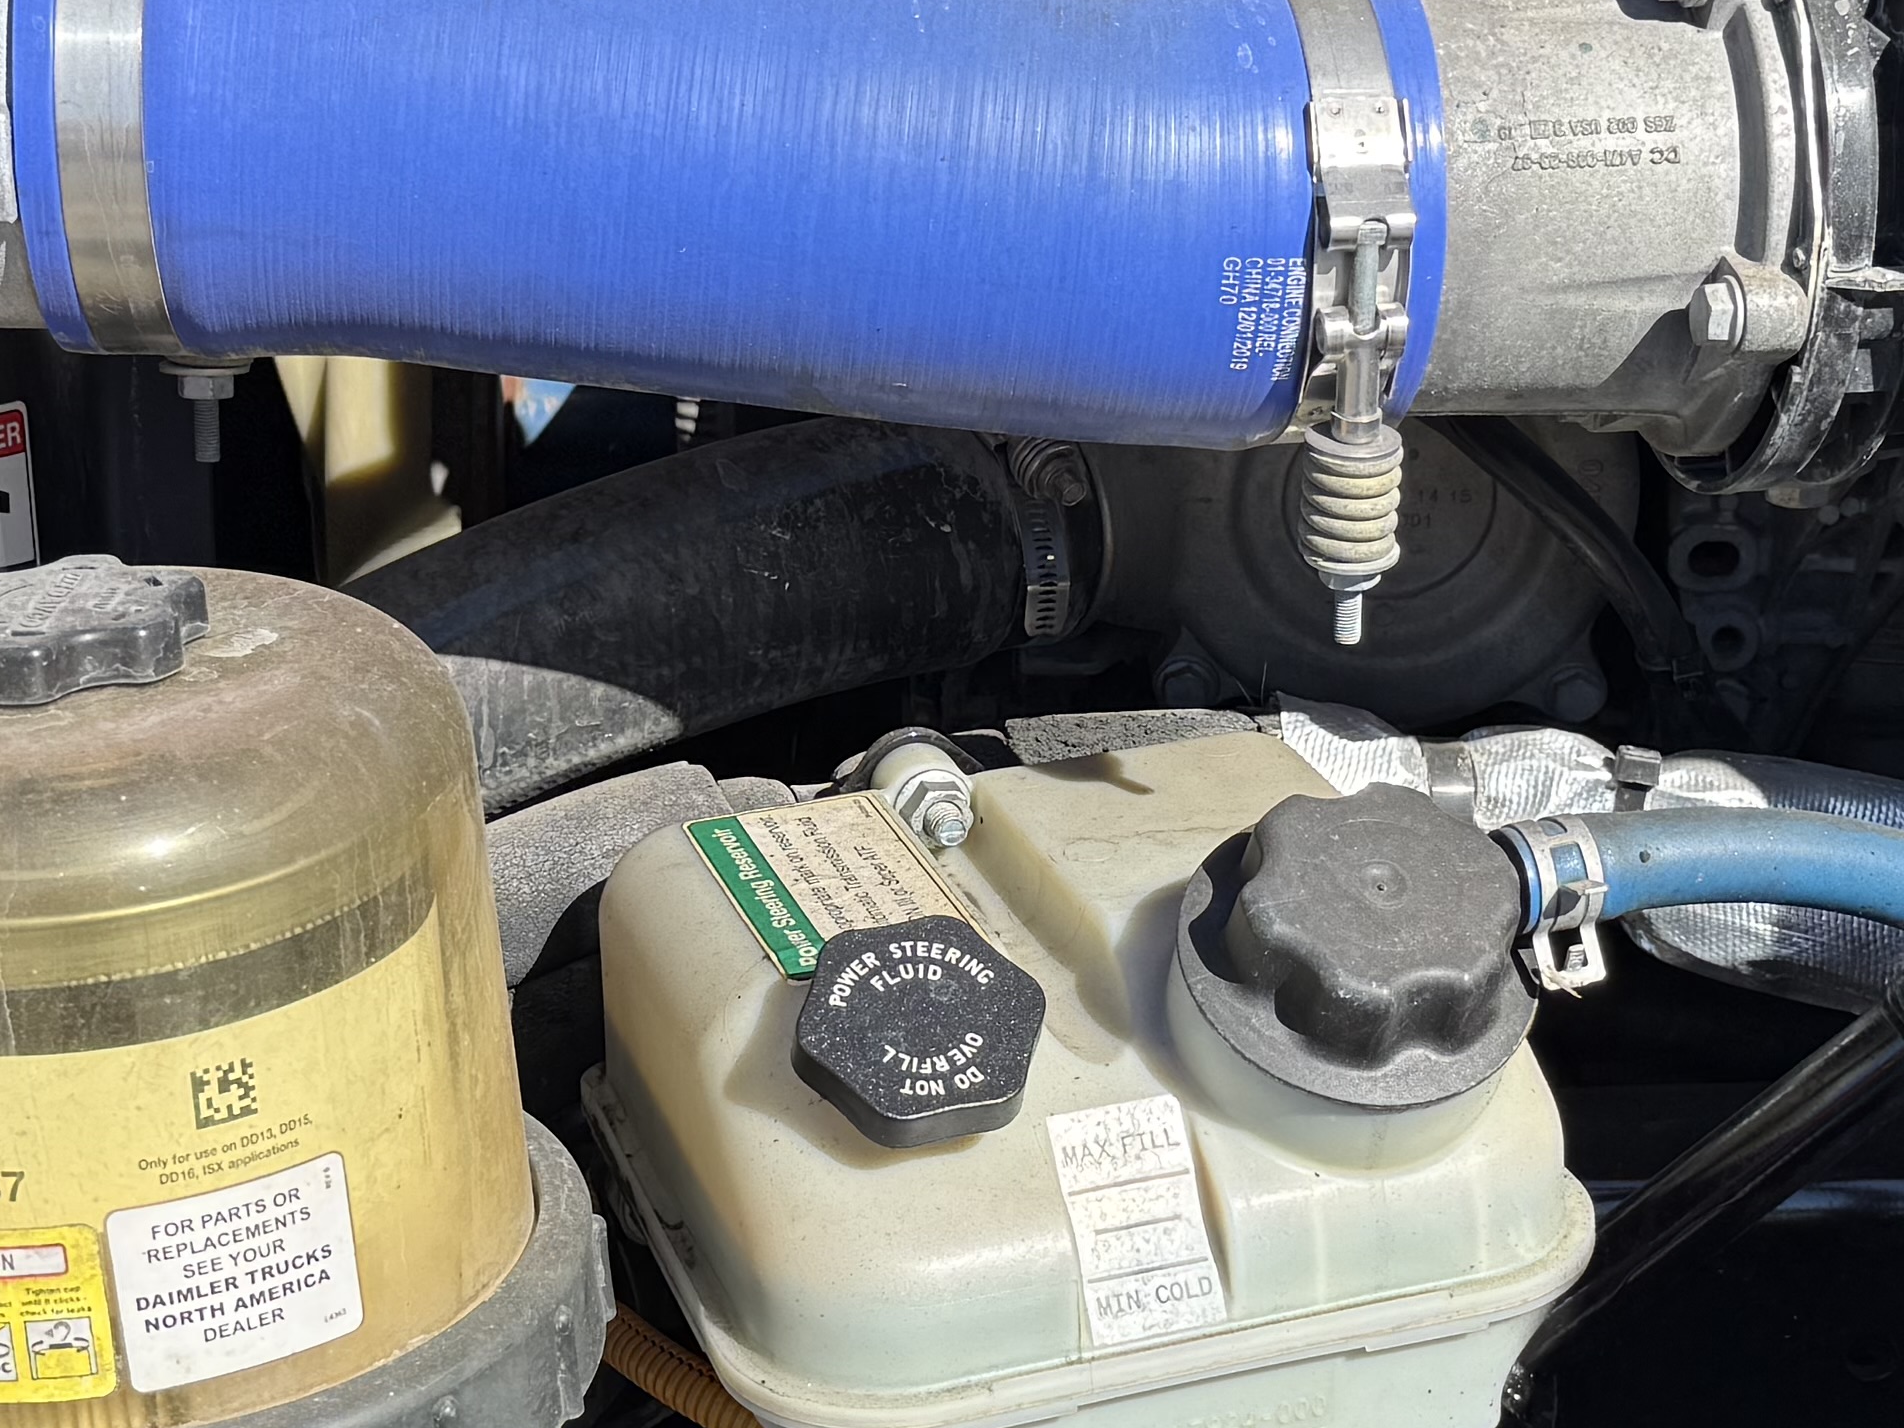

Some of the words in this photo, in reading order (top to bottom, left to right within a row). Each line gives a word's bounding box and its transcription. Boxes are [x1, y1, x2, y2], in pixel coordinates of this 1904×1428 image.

[1649, 146, 1681, 165] DC
[1219, 256, 1242, 305] GH70
[1241, 257, 1264, 303] CHINA
[1284, 257, 1307, 308] ENGINE
[1229, 307, 1258, 370] 12/01/2019
[1270, 308, 1302, 381] CONNECTION
[714, 828, 757, 881] Reservoir
[752, 878, 796, 929] Steering
[784, 928, 819, 968] Power
[828, 951, 881, 1008] POWER
[889, 941, 994, 985] STEERING
[869, 963, 942, 992] FLUID
[882, 1032, 984, 1074] OVERFILL
[899, 1078, 946, 1097] NOT
[953, 1066, 985, 1090] DO
[138, 1157, 168, 1172] Only
[172, 1152, 191, 1166] for
[195, 1148, 218, 1161] use
[221, 1141, 237, 1154] on
[240, 1127, 278, 1149] DD13,
[278, 1113, 313, 1135] DD15,
[159, 1166, 200, 1186] DD16,
[202, 1159, 225, 1176] ISX
[227, 1137, 300, 1172] applications
[1060, 1139, 1113, 1169] MAX
[1121, 1127, 1182, 1156] FILL
[147, 1206, 312, 1264] REPLACEMENTS
[150, 1218, 195, 1241] FOR
[200, 1198, 267, 1229] PARTS
[272, 1187, 302, 1208] OR
[135, 1275, 240, 1312] DAIMLER
[244, 1244, 333, 1286] TRUCKS
[182, 1256, 224, 1280] SEE
[229, 1237, 286, 1267] YOUR
[144, 1301, 225, 1334] NORTH
[233, 1268, 331, 1313] AMERICA
[1095, 1290, 1142, 1321] MIN
[1154, 1276, 1214, 1305] COLD
[203, 1307, 285, 1343] DEALER
